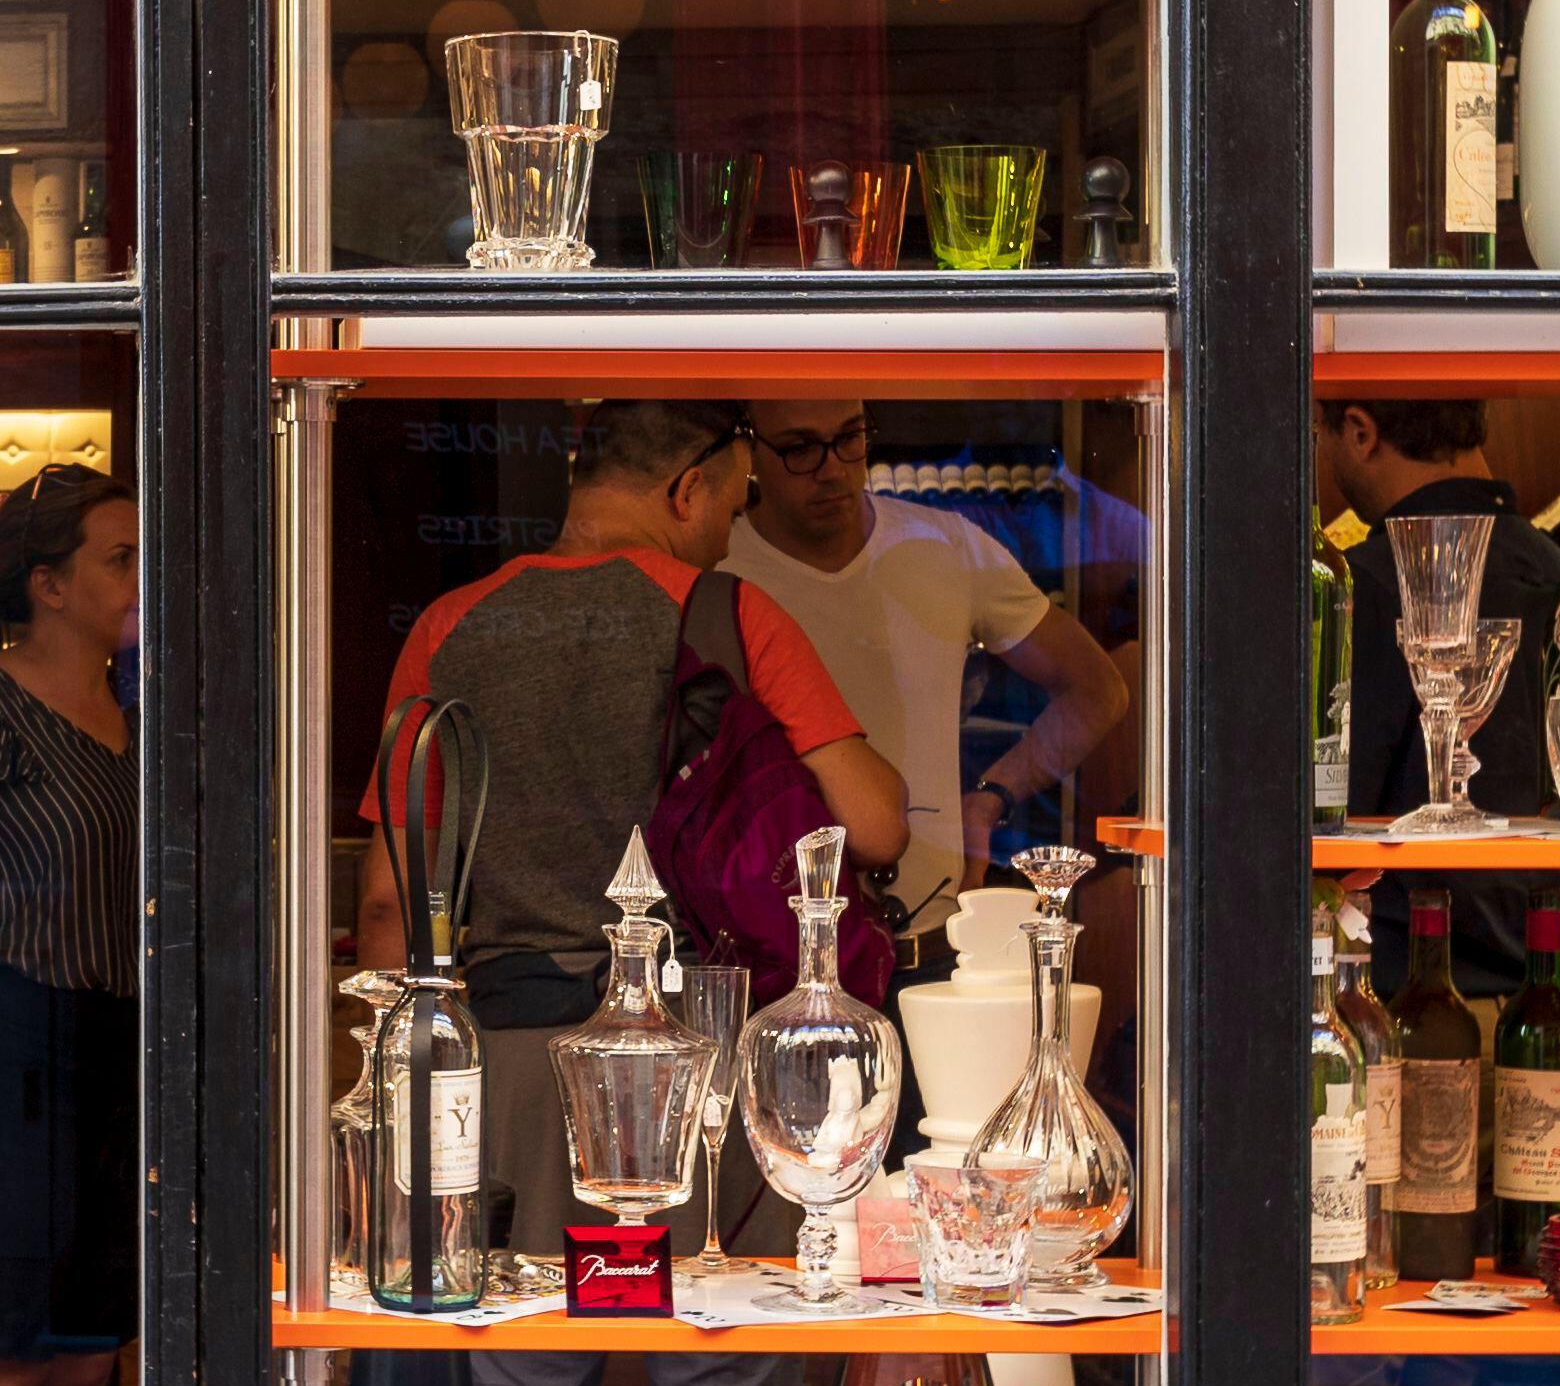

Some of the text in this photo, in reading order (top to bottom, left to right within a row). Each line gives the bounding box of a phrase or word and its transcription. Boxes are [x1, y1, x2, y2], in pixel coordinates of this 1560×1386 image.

[447, 1107, 473, 1138] Y
[1373, 1099, 1396, 1129] Y
[577, 1254, 661, 1286] Baccarat
